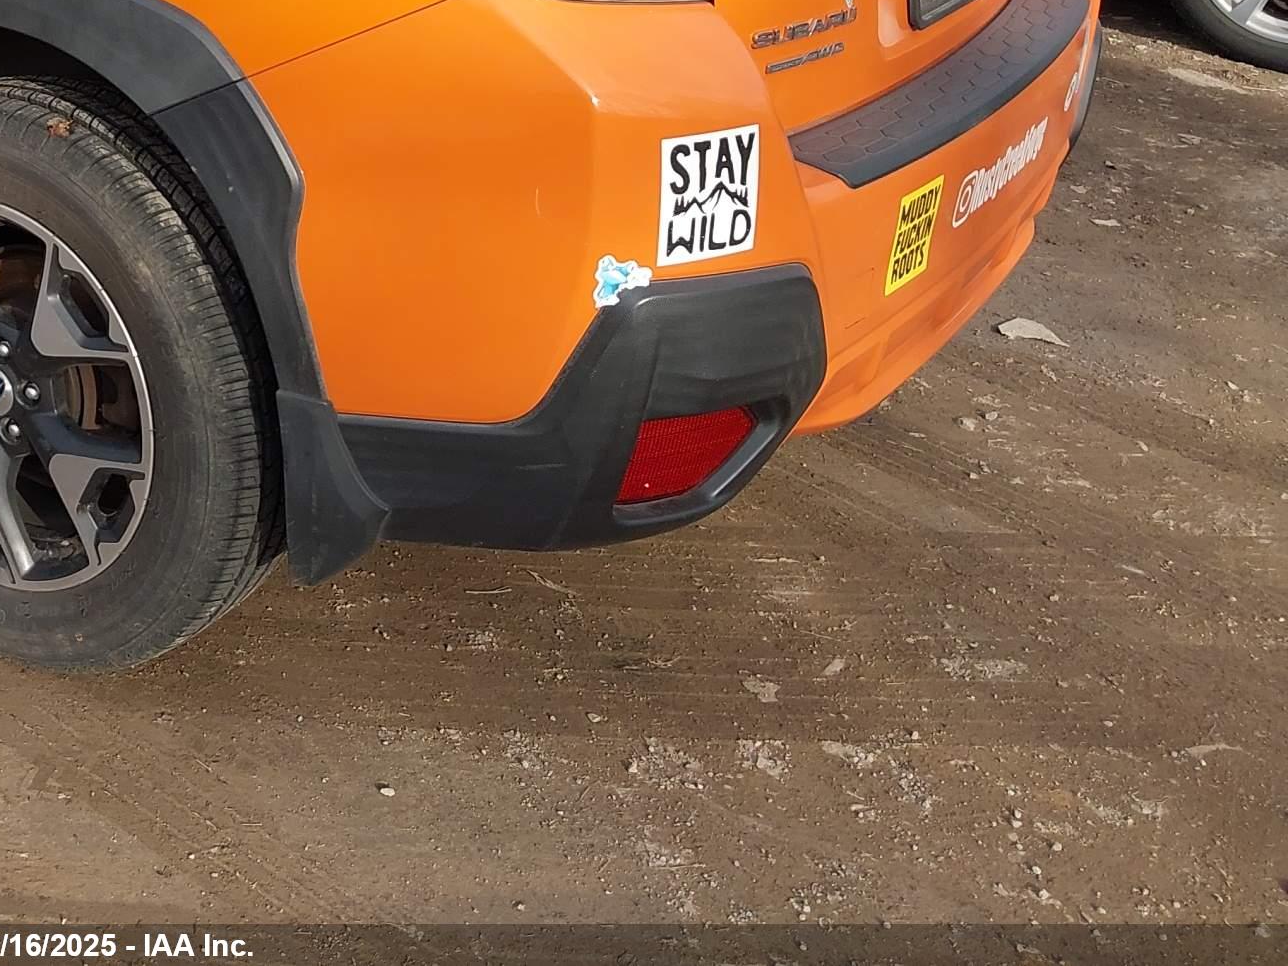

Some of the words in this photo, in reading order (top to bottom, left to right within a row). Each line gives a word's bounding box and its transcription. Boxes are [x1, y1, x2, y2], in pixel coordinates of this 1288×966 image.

[751, 6, 857, 49] SUBARU
[670, 133, 756, 195] STAY
[900, 184, 942, 231] MUDDY
[666, 209, 752, 259] WILD
[895, 213, 938, 256] FUCKIN
[890, 244, 928, 286] ROOTS
